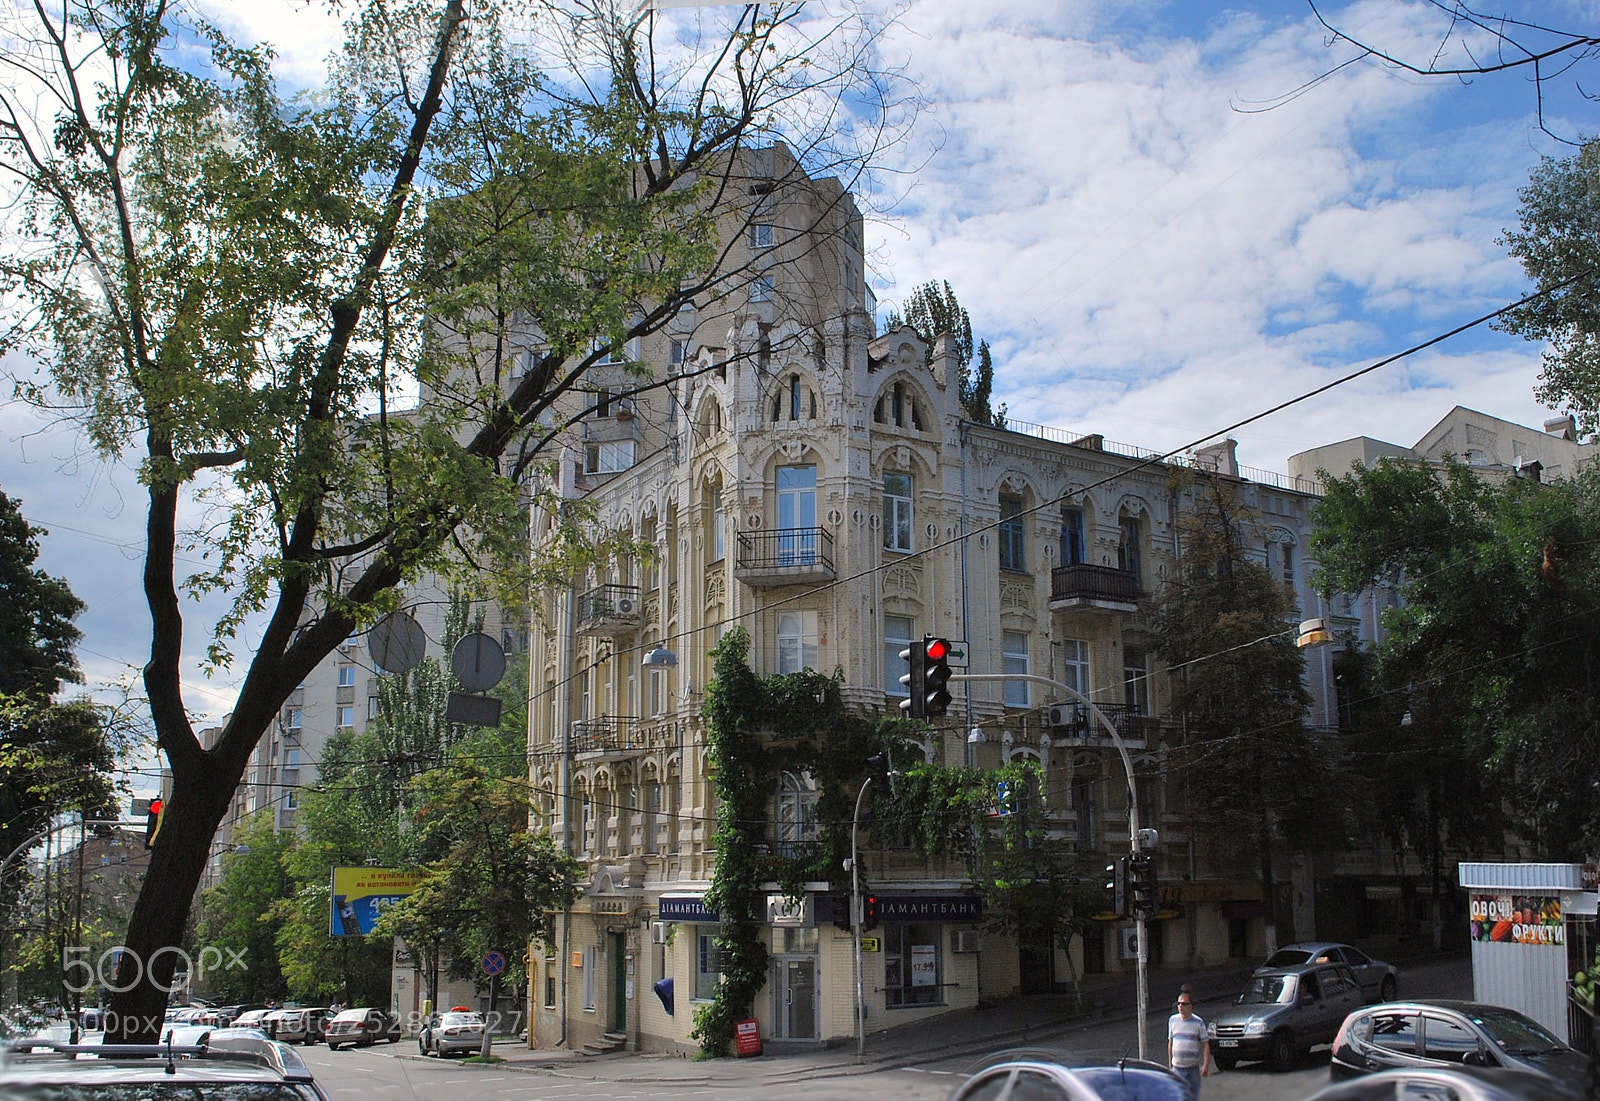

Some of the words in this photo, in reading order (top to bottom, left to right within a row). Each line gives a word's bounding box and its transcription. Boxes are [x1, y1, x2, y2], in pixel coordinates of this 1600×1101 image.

[880, 903, 976, 913] ІАМАНТБАНК
[1472, 900, 1510, 917] ОВОЧІ
[1512, 924, 1563, 941] ФРУКТИ
